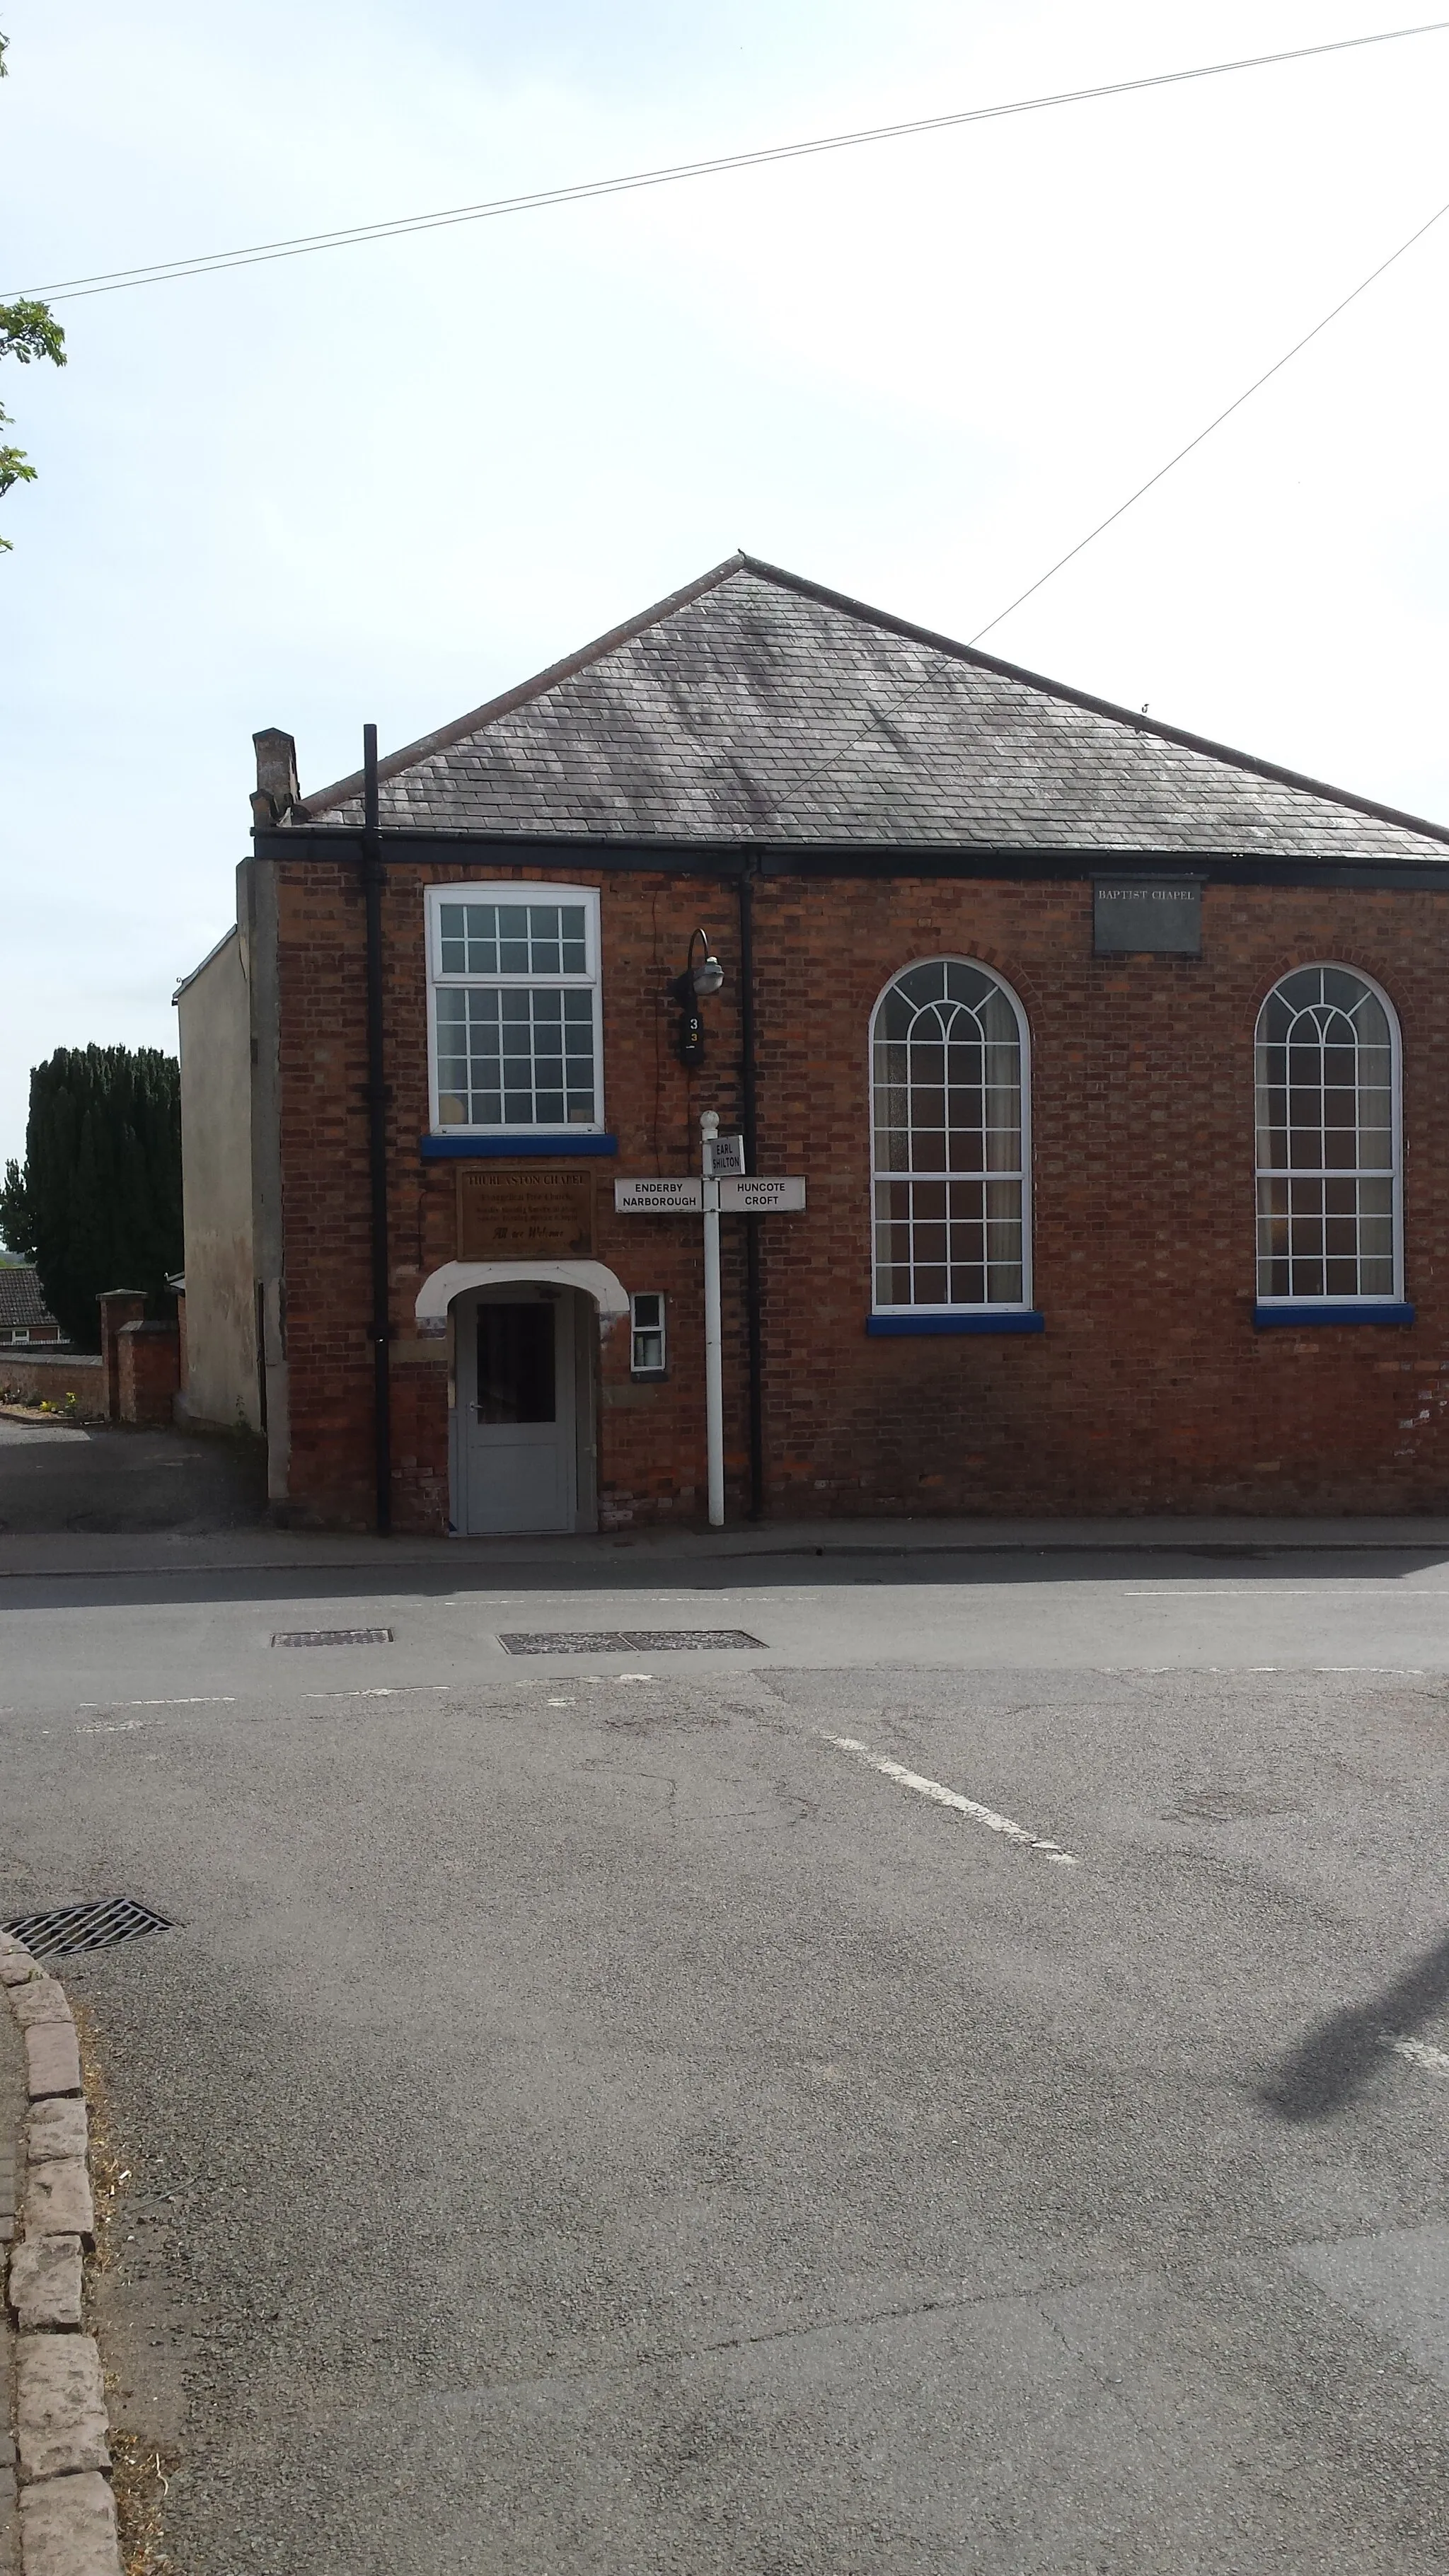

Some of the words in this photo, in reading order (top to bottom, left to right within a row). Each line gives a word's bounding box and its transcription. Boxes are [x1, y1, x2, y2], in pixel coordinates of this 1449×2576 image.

[1099, 890, 1148, 900] BAPTIST
[1152, 891, 1194, 900] CHAPEL
[690, 1018, 698, 1029] 3
[716, 1143, 733, 1155] EARL
[712, 1156, 740, 1169] SHILTON
[468, 1175, 540, 1185] THURLASTON
[543, 1175, 586, 1185] CHAPEL
[635, 1184, 683, 1192] ENDERBY
[737, 1183, 785, 1191] HUNCOTE
[623, 1197, 696, 1206] NARBOROUGH
[745, 1196, 778, 1205] CROFT
